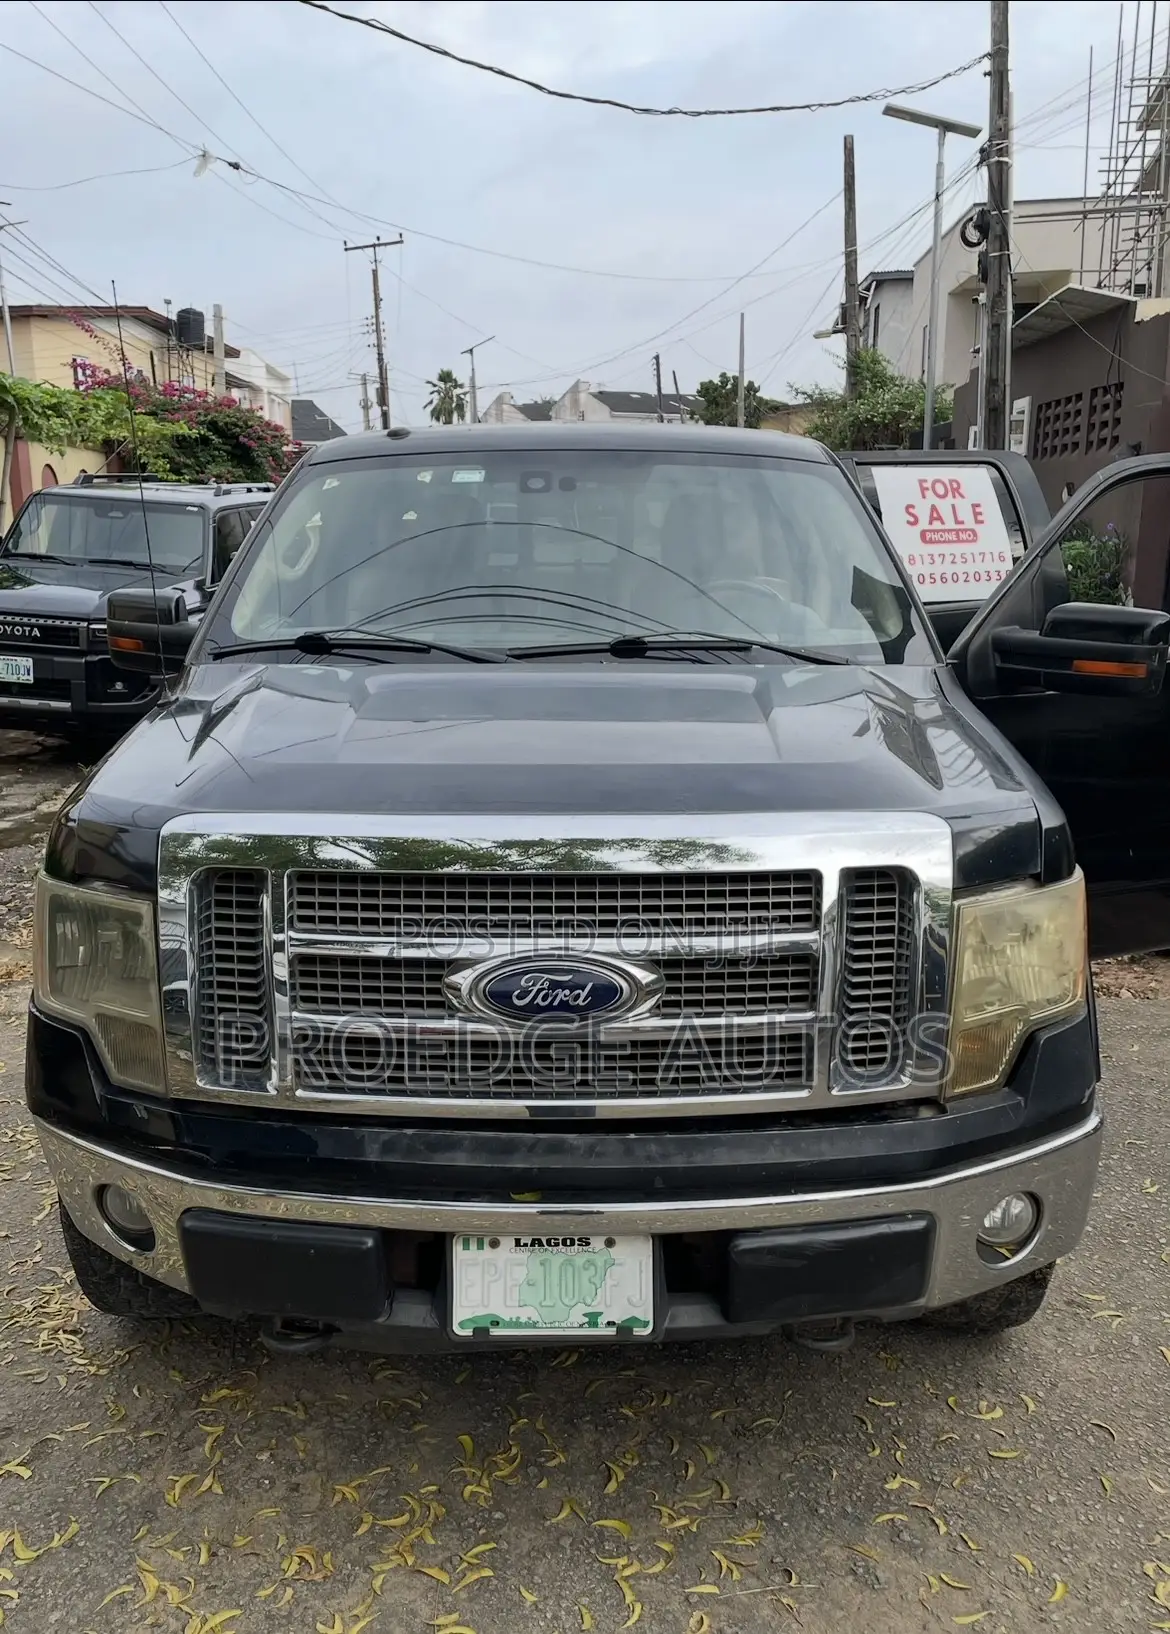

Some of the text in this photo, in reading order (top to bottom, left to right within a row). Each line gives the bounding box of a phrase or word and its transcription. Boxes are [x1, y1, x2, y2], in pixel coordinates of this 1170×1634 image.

[917, 478, 966, 500] FOR
[904, 503, 985, 526] SALE
[925, 531, 977, 541] PHONE NO.
[901, 552, 1005, 566] 8137251716
[909, 570, 1011, 584] 05602033
[511, 972, 594, 1007] Ford
[513, 1236, 592, 1248] LAGOS
[508, 1246, 536, 1254] CENTRE
[551, 1246, 597, 1254] EXCELLENCE
